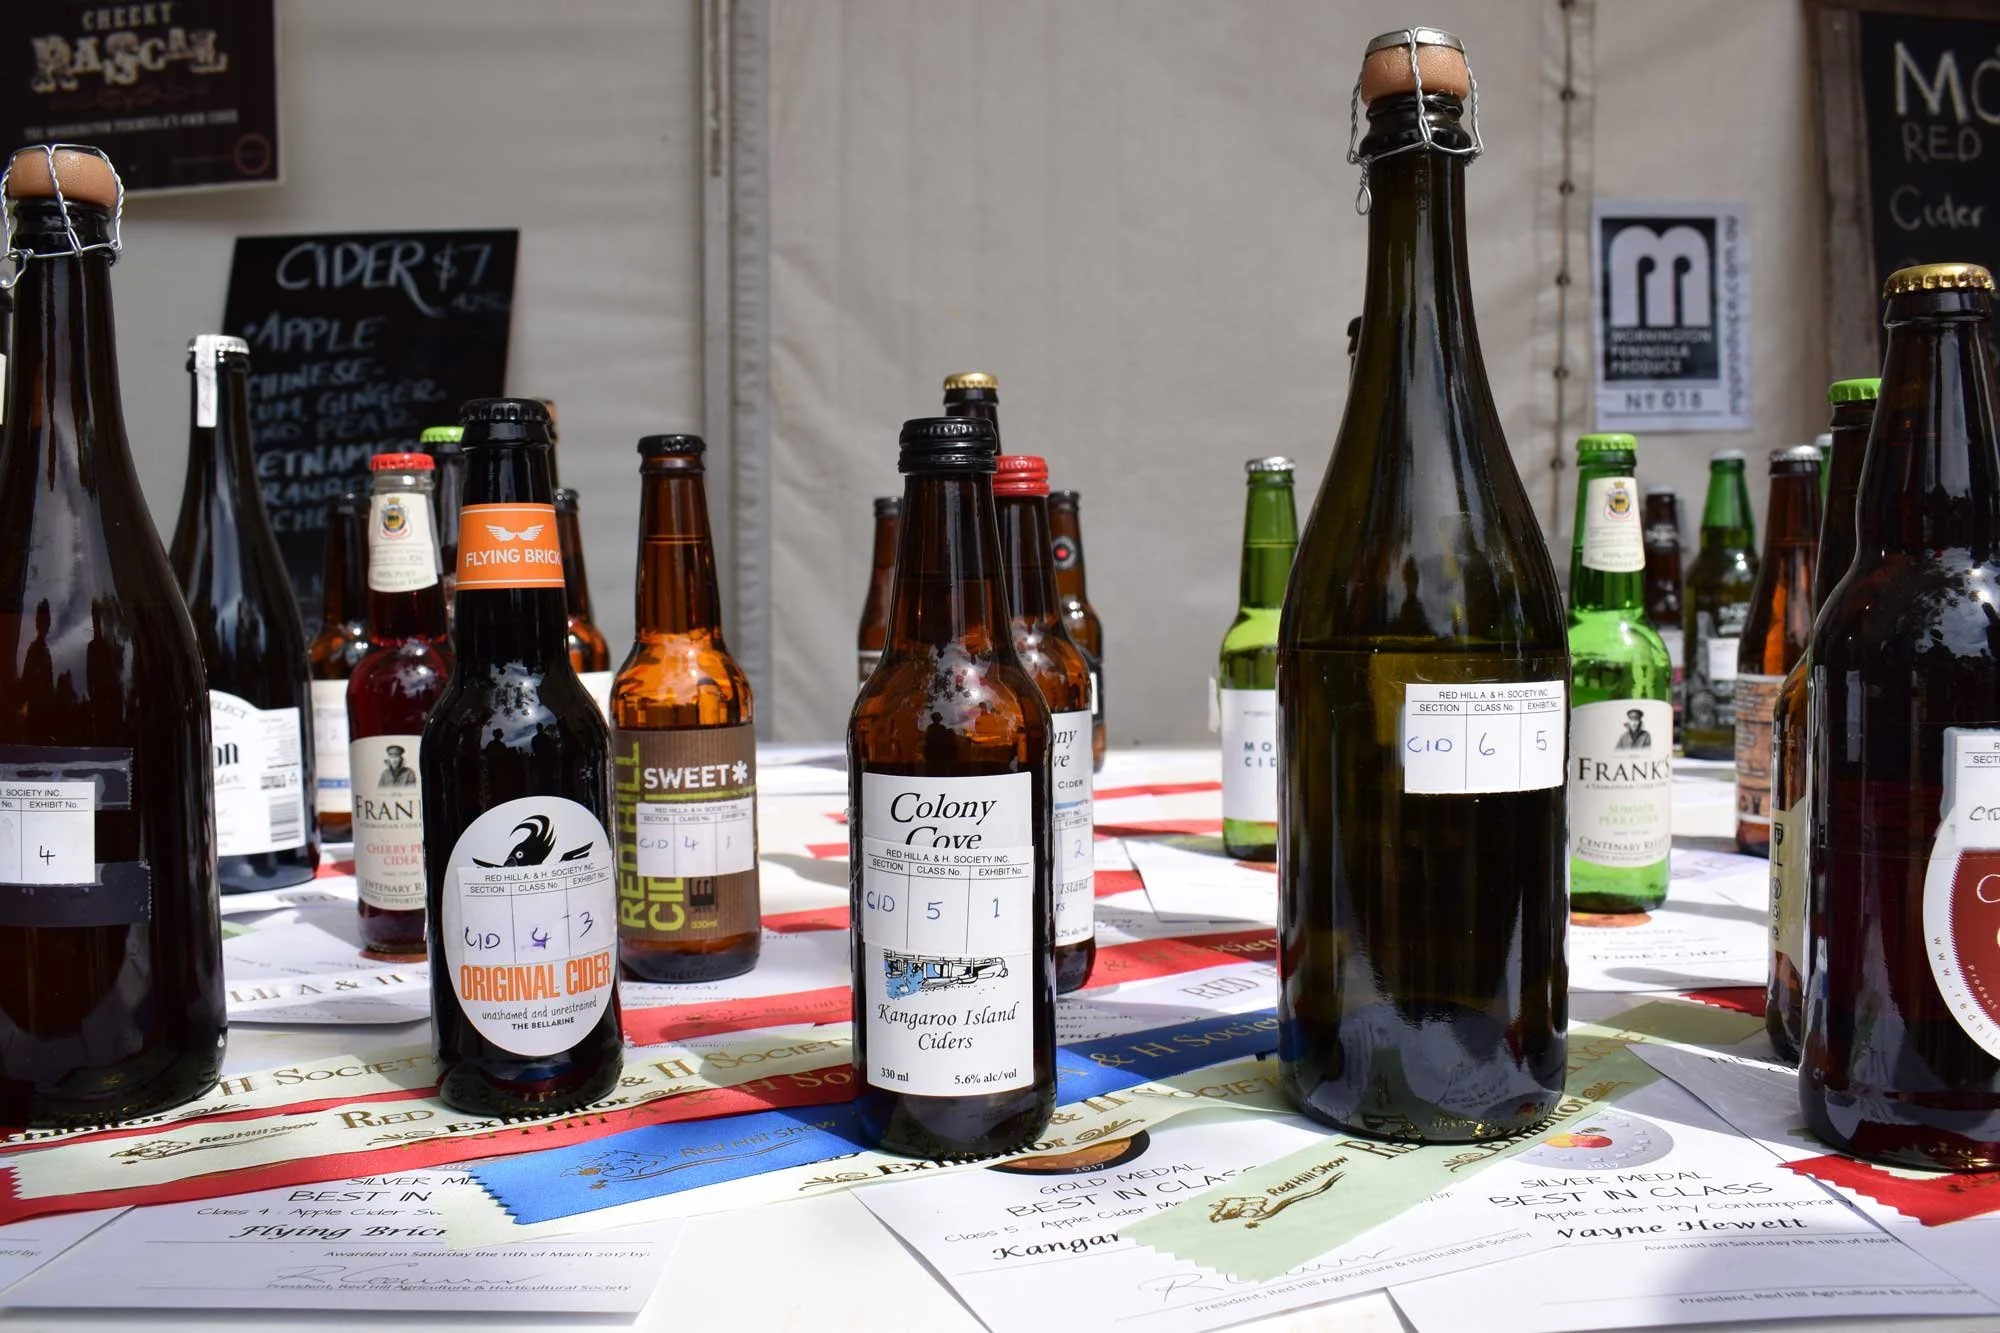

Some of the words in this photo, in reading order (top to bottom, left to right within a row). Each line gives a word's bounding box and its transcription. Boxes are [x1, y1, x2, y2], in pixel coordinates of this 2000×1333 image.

[82, 3, 173, 31] CHEEKY
[30, 28, 228, 93] RASCAL
[1901, 122, 1983, 163] RED
[1889, 185, 1985, 232] Cider
[276, 240, 443, 318] CIDER
[256, 310, 386, 351] APPLE
[465, 547, 520, 568] FLYING
[1438, 691, 1458, 699] RED
[1460, 691, 1478, 699] HILL
[1490, 690, 1496, 699] &
[1507, 689, 1537, 698] SOCIETY
[1419, 703, 1460, 712] SECTION
[1474, 703, 1502, 712] CLASS
[1527, 702, 1550, 710] EXHIBIT
[1407, 735, 1453, 753] CID
[1479, 732, 1496, 756] 6
[1536, 730, 1548, 751] 5
[643, 762, 731, 790] SWEET
[1058, 779, 1084, 790] CIDER
[6, 789, 42, 797] SOCIETY
[29, 800, 63, 809] EXHIBIT
[65, 800, 79, 809] No.
[355, 794, 423, 821] FRAN
[890, 791, 997, 826] Colony
[640, 838, 670, 850] CID
[684, 835, 699, 851] 4
[905, 826, 982, 850] Cove
[1579, 836, 1641, 852] CENTENARY
[39, 845, 56, 866] 4
[886, 848, 903, 859] RED
[904, 852, 921, 861] HILL
[953, 856, 993, 864] SOCIETY
[1074, 839, 1085, 859] 2
[383, 855, 419, 866] CIDER
[872, 857, 904, 871] SECTION
[916, 865, 946, 876] CLASS
[948, 868, 961, 876] No.
[978, 867, 1011, 877] EXHIBIT
[470, 886, 505, 894] SECTION
[518, 884, 546, 893] CLASS
[547, 882, 559, 890] No.
[572, 874, 598, 885] EXHIBIT
[485, 873, 502, 882] RED
[504, 873, 520, 881] HILL
[551, 865, 583, 878] SOCIETY
[866, 890, 895, 913] CID
[926, 901, 944, 920] 5
[992, 897, 1001, 918] 1
[579, 911, 595, 939] 3
[460, 963, 561, 1002] ORIGINAL
[565, 951, 612, 996] CIDER
[481, 1006, 528, 1021] unashamed
[530, 1005, 549, 1019] and
[550, 999, 598, 1017] unrestrained
[877, 1001, 957, 1031] Kangaroo
[963, 1000, 1021, 1027] Island
[511, 1022, 530, 1031] THE
[531, 1016, 576, 1030] BELLARINE
[916, 1031, 974, 1052] Ciders
[1089, 1051, 1136, 1067] &
[1130, 1042, 1179, 1058] H
[619, 1075, 651, 1089] &
[649, 1058, 700, 1082] H
[880, 1067, 895, 1080] 330
[896, 1071, 910, 1083] ml
[953, 1072, 981, 1086] 5.6%
[983, 1067, 1018, 1084] alc/vol
[218, 1076, 254, 1098] H
[334, 1109, 435, 1131] RED
[199, 1133, 236, 1144] Red
[272, 1120, 319, 1135] Show
[680, 1141, 726, 1158] Red
[730, 1133, 770, 1150] Hill
[773, 1119, 837, 1139] Show
[1071, 1163, 1105, 1174] 2017
[1265, 1180, 1294, 1197] Red
[1293, 1168, 1320, 1187] Hill
[1315, 1153, 1349, 1176] Show
[346, 1177, 432, 1187] SILVER
[1039, 1178, 1108, 1197] GOLD
[1116, 1162, 1206, 1184] MEDAL
[1520, 1176, 1609, 1189] SILVER
[1617, 1170, 1713, 1184] MEDAL
[287, 1190, 391, 1202] BEST
[399, 1190, 433, 1202] IN
[1005, 1192, 1099, 1217] BEST
[1112, 1186, 1149, 1201] IN
[1488, 1191, 1587, 1208] BEST
[1602, 1188, 1639, 1201] IN
[1649, 1181, 1774, 1199] CLASS
[197, 1207, 249, 1216] Class
[258, 1207, 270, 1216] 4
[287, 1207, 343, 1219] Apple
[350, 1207, 406, 1217] Cider
[1533, 1210, 1586, 1222] Apple
[1593, 1205, 1649, 1216] Cider
[1658, 1203, 1700, 1214] Dry
[229, 1223, 353, 1240] Flying
[944, 1229, 999, 1244] Class
[1003, 1225, 1019, 1235] 5
[1040, 1214, 1092, 1231] Apple
[1096, 1204, 1147, 1219] Cider
[1677, 1216, 1808, 1233] Hewett
[412, 1250, 472, 1260] Saturday
[1643, 1241, 1707, 1251] Awarded
